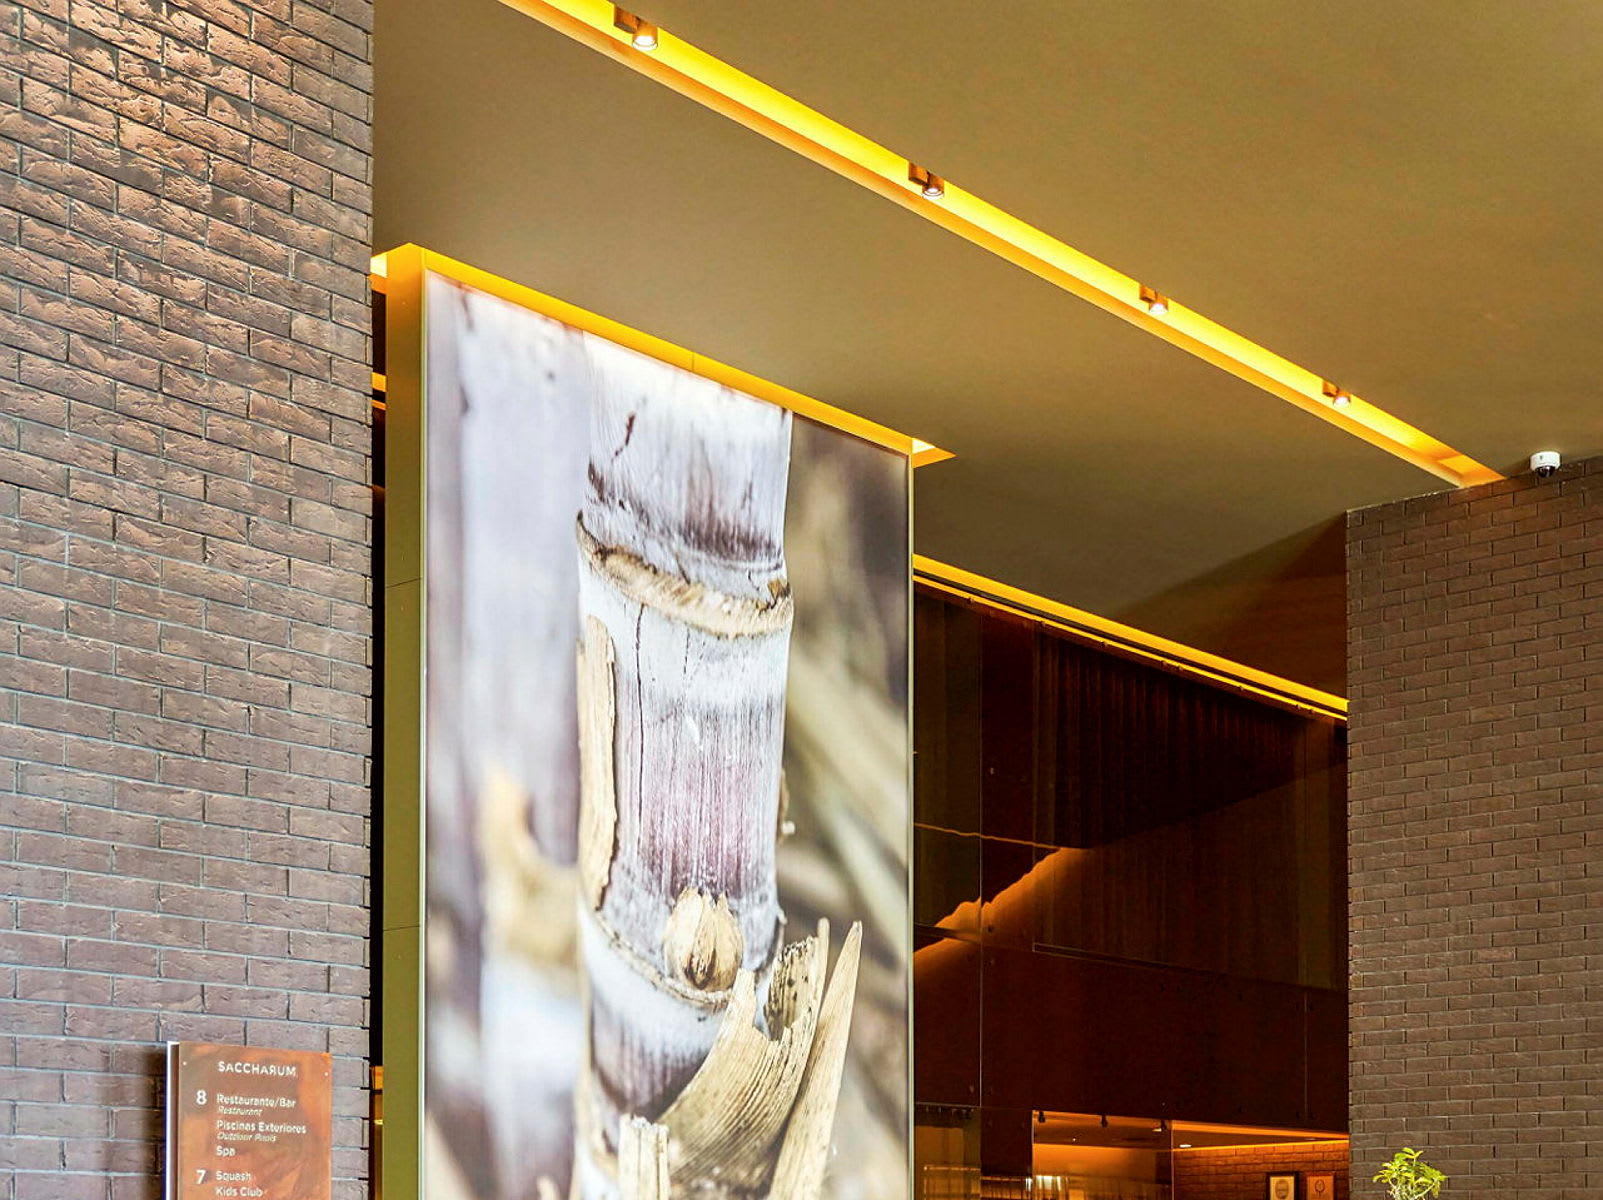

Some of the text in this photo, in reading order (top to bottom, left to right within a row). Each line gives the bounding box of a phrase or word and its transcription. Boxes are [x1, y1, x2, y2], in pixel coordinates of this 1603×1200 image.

[196, 1090, 207, 1105] 8
[216, 1094, 296, 1109] Restaurante/Bar
[216, 1120, 307, 1134] Piscinas Exteriores
[216, 1146, 236, 1157] Spa
[196, 1170, 206, 1184] 7
[216, 1171, 251, 1182] Squash
[216, 1187, 263, 1196] Kids Club
